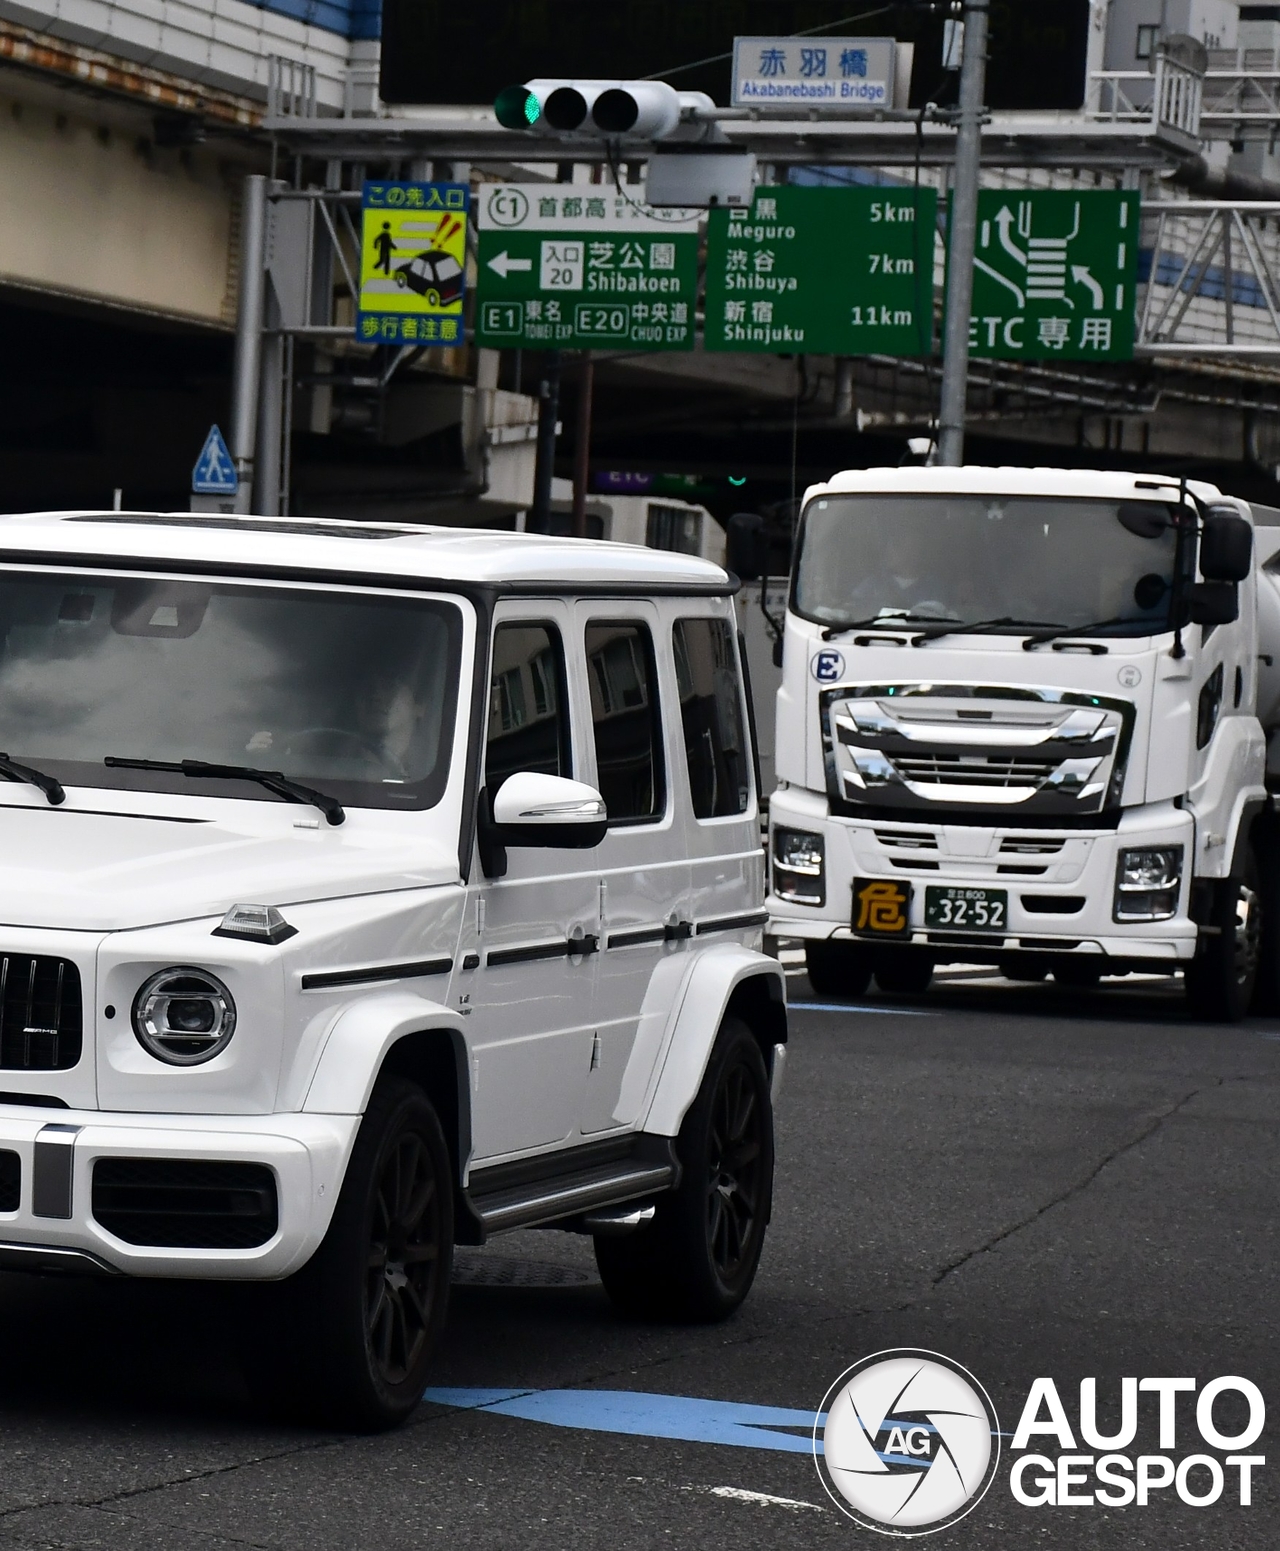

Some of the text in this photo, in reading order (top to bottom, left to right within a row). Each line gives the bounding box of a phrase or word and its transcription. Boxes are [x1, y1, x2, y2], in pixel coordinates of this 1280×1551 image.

[759, 48, 868, 78] 赤羽橋
[742, 82, 884, 100] Akabanebashi Bridge
[369, 186, 465, 208] この先入口
[538, 197, 606, 219] 首都高
[870, 202, 915, 223] 5km
[727, 223, 796, 243] Meguro
[545, 246, 580, 264] 入口
[588, 242, 675, 270] 芝公園
[726, 249, 775, 272] 渋谷
[869, 254, 914, 275] 7km
[550, 268, 573, 285] 20
[587, 271, 680, 293] Shibakoen
[725, 273, 798, 294] Shibuya
[488, 308, 515, 329] E1
[525, 301, 562, 322] 東名
[580, 310, 625, 331] E20
[631, 301, 688, 324] 中央道
[724, 300, 774, 323] 新宿
[851, 306, 912, 326] 11km
[362, 316, 458, 341] 歩行者注意
[631, 326, 688, 342] CHUO EXP
[723, 324, 804, 345] Shinjuku
[1037, 316, 1112, 350] 専用
[857, 881, 907, 932] 危
[939, 898, 1004, 927] 32-52
